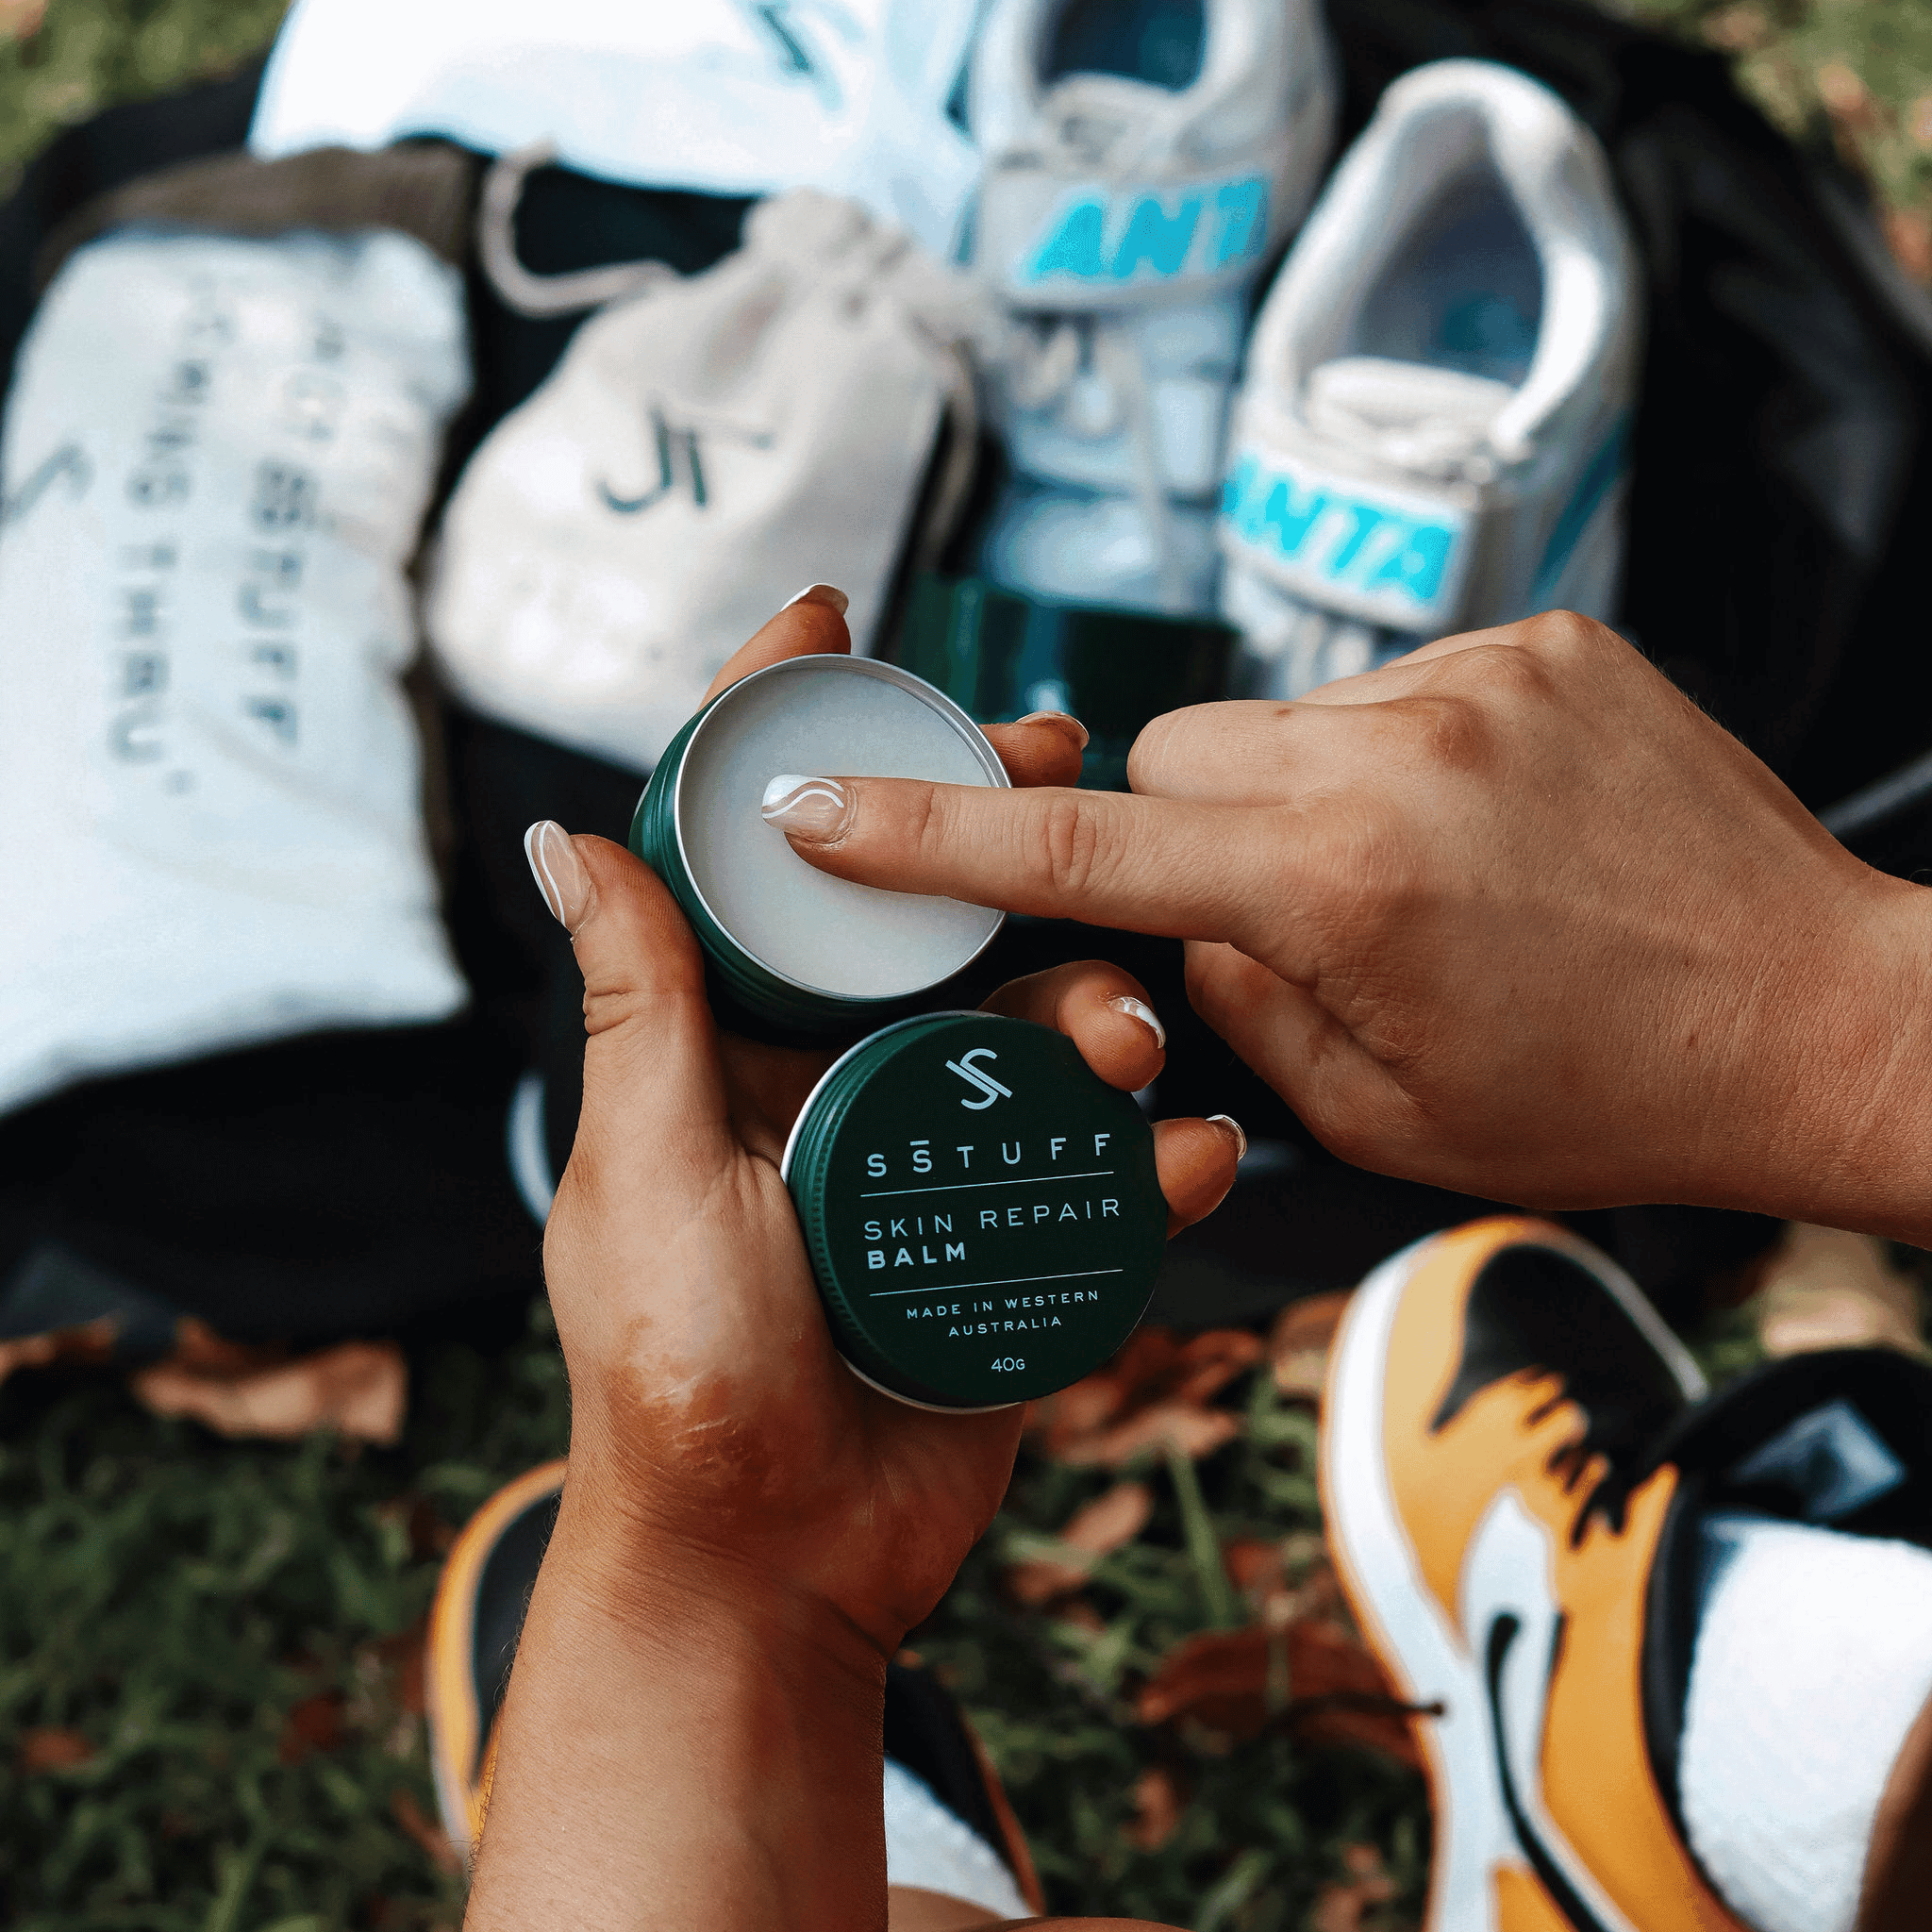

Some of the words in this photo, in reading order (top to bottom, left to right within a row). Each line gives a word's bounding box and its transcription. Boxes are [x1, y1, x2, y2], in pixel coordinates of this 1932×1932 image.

[864, 1213, 953, 1241] SKIN
[979, 1198, 1120, 1229] REPAIR
[867, 1241, 966, 1270] BALM
[907, 1304, 961, 1320] MADE
[974, 1300, 992, 1313] IN
[1004, 1290, 1098, 1309] WESTERN
[948, 1316, 1062, 1338] AUSTRALIA
[991, 1357, 1026, 1373] 40G
